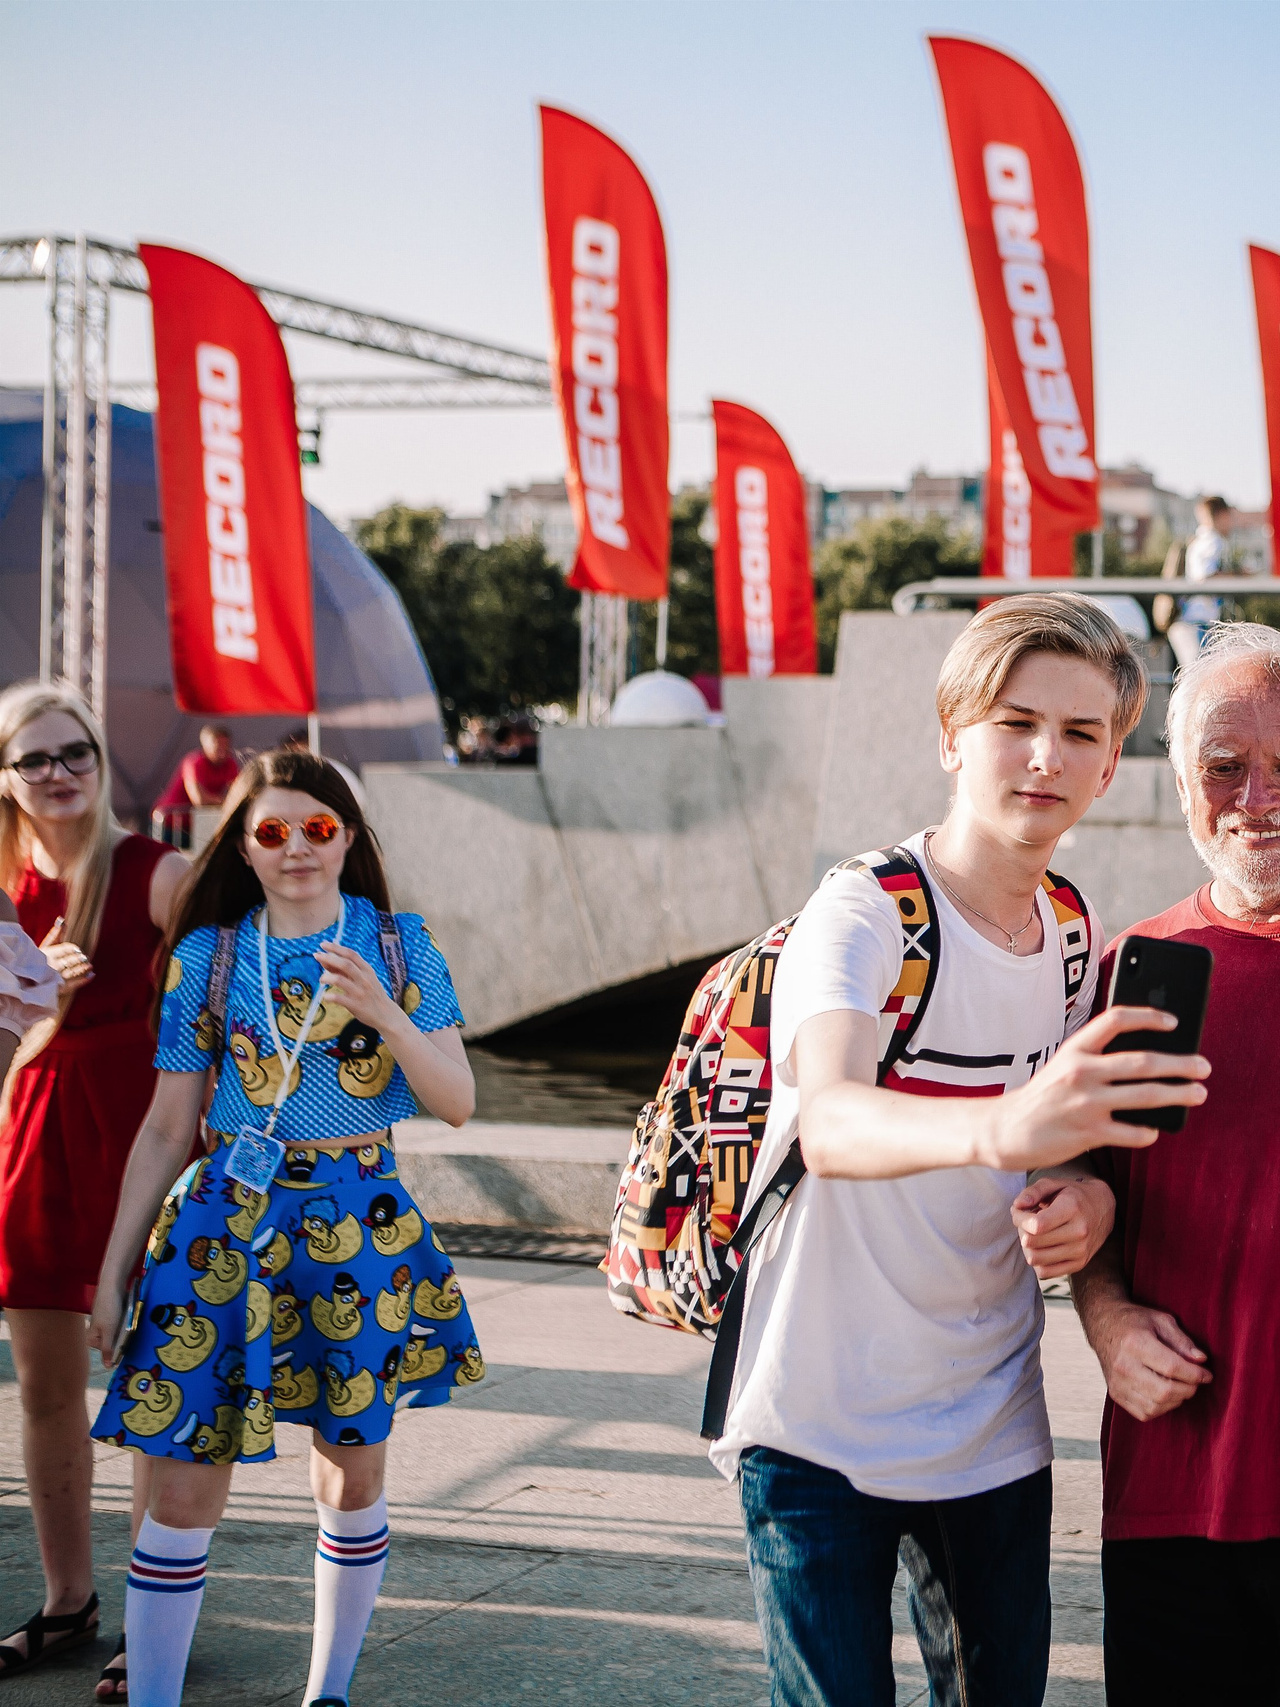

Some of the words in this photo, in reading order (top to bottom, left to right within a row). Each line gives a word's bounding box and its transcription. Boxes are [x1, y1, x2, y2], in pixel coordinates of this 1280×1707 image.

[571, 215, 631, 551] RECORD
[982, 141, 1099, 482] RECORD
[195, 341, 260, 664] RECORD
